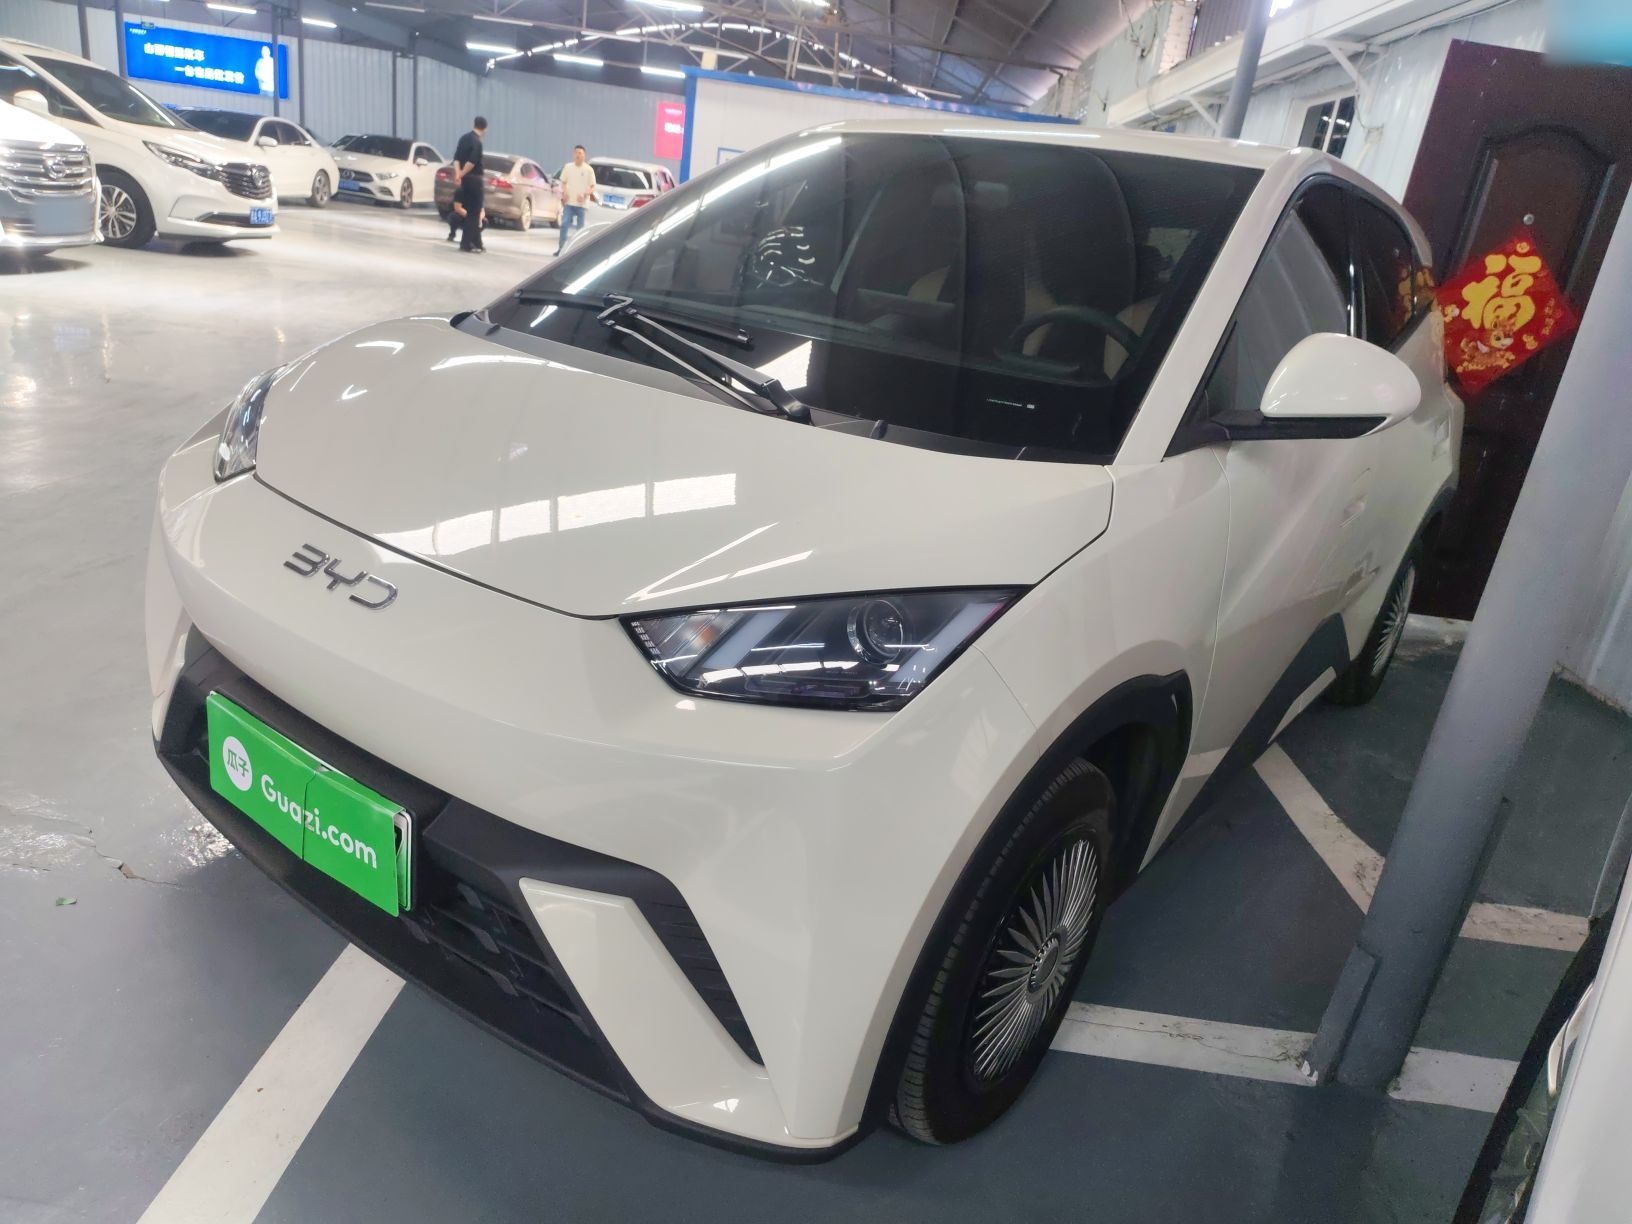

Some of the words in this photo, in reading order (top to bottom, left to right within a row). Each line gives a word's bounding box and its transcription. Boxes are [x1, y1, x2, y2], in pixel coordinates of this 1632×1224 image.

[1461, 254, 1541, 331] 福
[283, 543, 398, 611] BYD
[226, 747, 250, 778] 瓜子
[260, 774, 377, 869] Guazi.com
